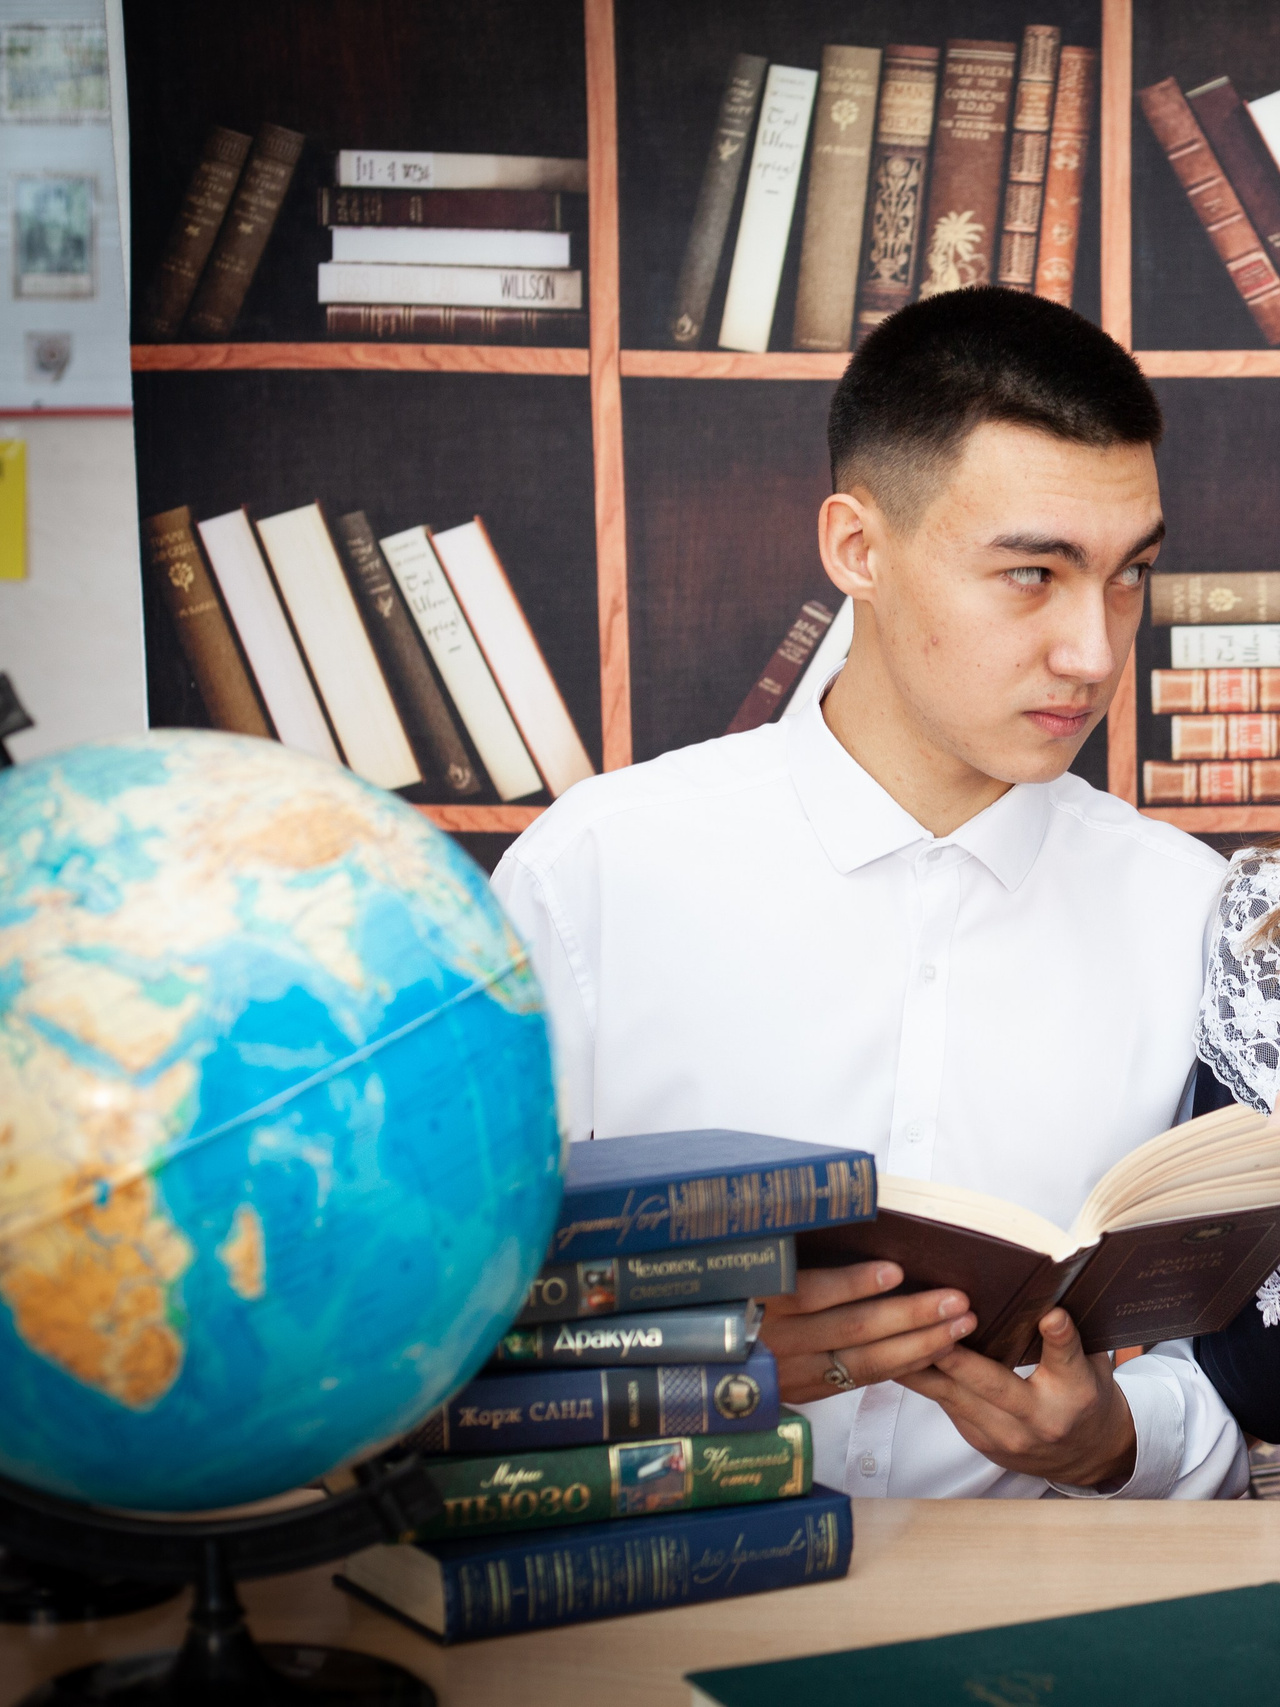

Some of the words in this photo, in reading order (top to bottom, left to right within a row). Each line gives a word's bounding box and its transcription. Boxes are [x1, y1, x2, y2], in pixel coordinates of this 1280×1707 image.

[956, 101, 996, 114] ROAD
[501, 272, 556, 300] WILLSON
[628, 1257, 704, 1280] Человек,
[706, 1247, 777, 1272] который
[530, 1276, 569, 1307] ГО
[553, 1323, 664, 1358] Дракула
[458, 1405, 523, 1430] Жорж
[528, 1397, 595, 1423] САНД
[480, 1461, 544, 1492] Марио
[444, 1482, 592, 1528] ПЬЮЗО
